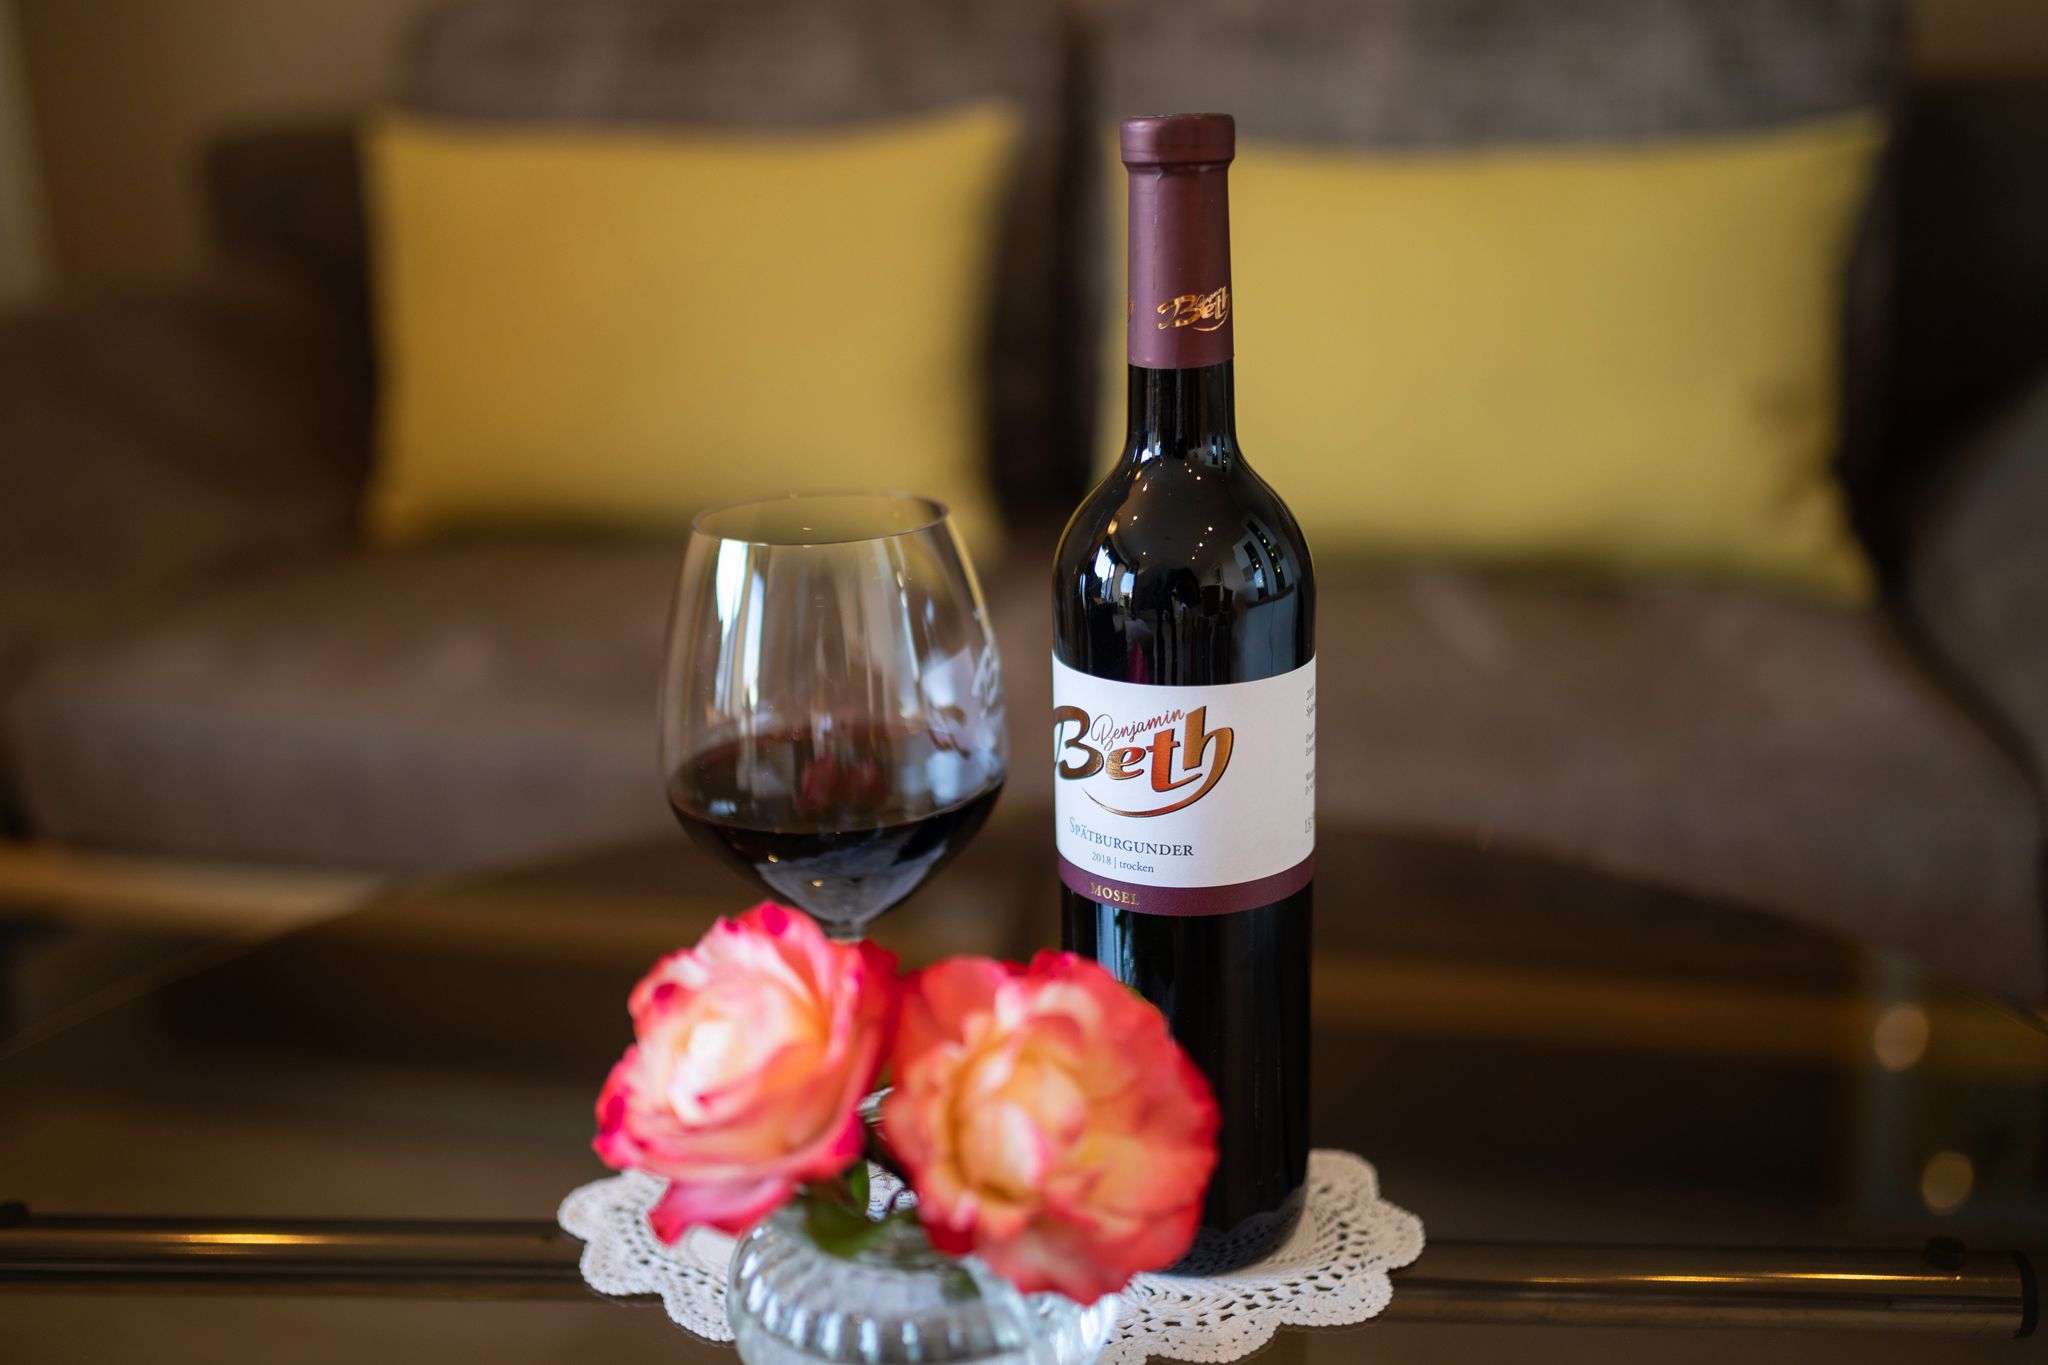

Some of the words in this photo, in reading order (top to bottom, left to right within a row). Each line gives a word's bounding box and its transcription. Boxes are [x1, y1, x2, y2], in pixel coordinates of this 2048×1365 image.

[1090, 707, 1185, 751] Benjamin
[1053, 704, 1234, 818] Beth
[1091, 851, 1112, 866] 2018
[1119, 861, 1155, 873] trocken
[1090, 881, 1141, 906] MOSEL
